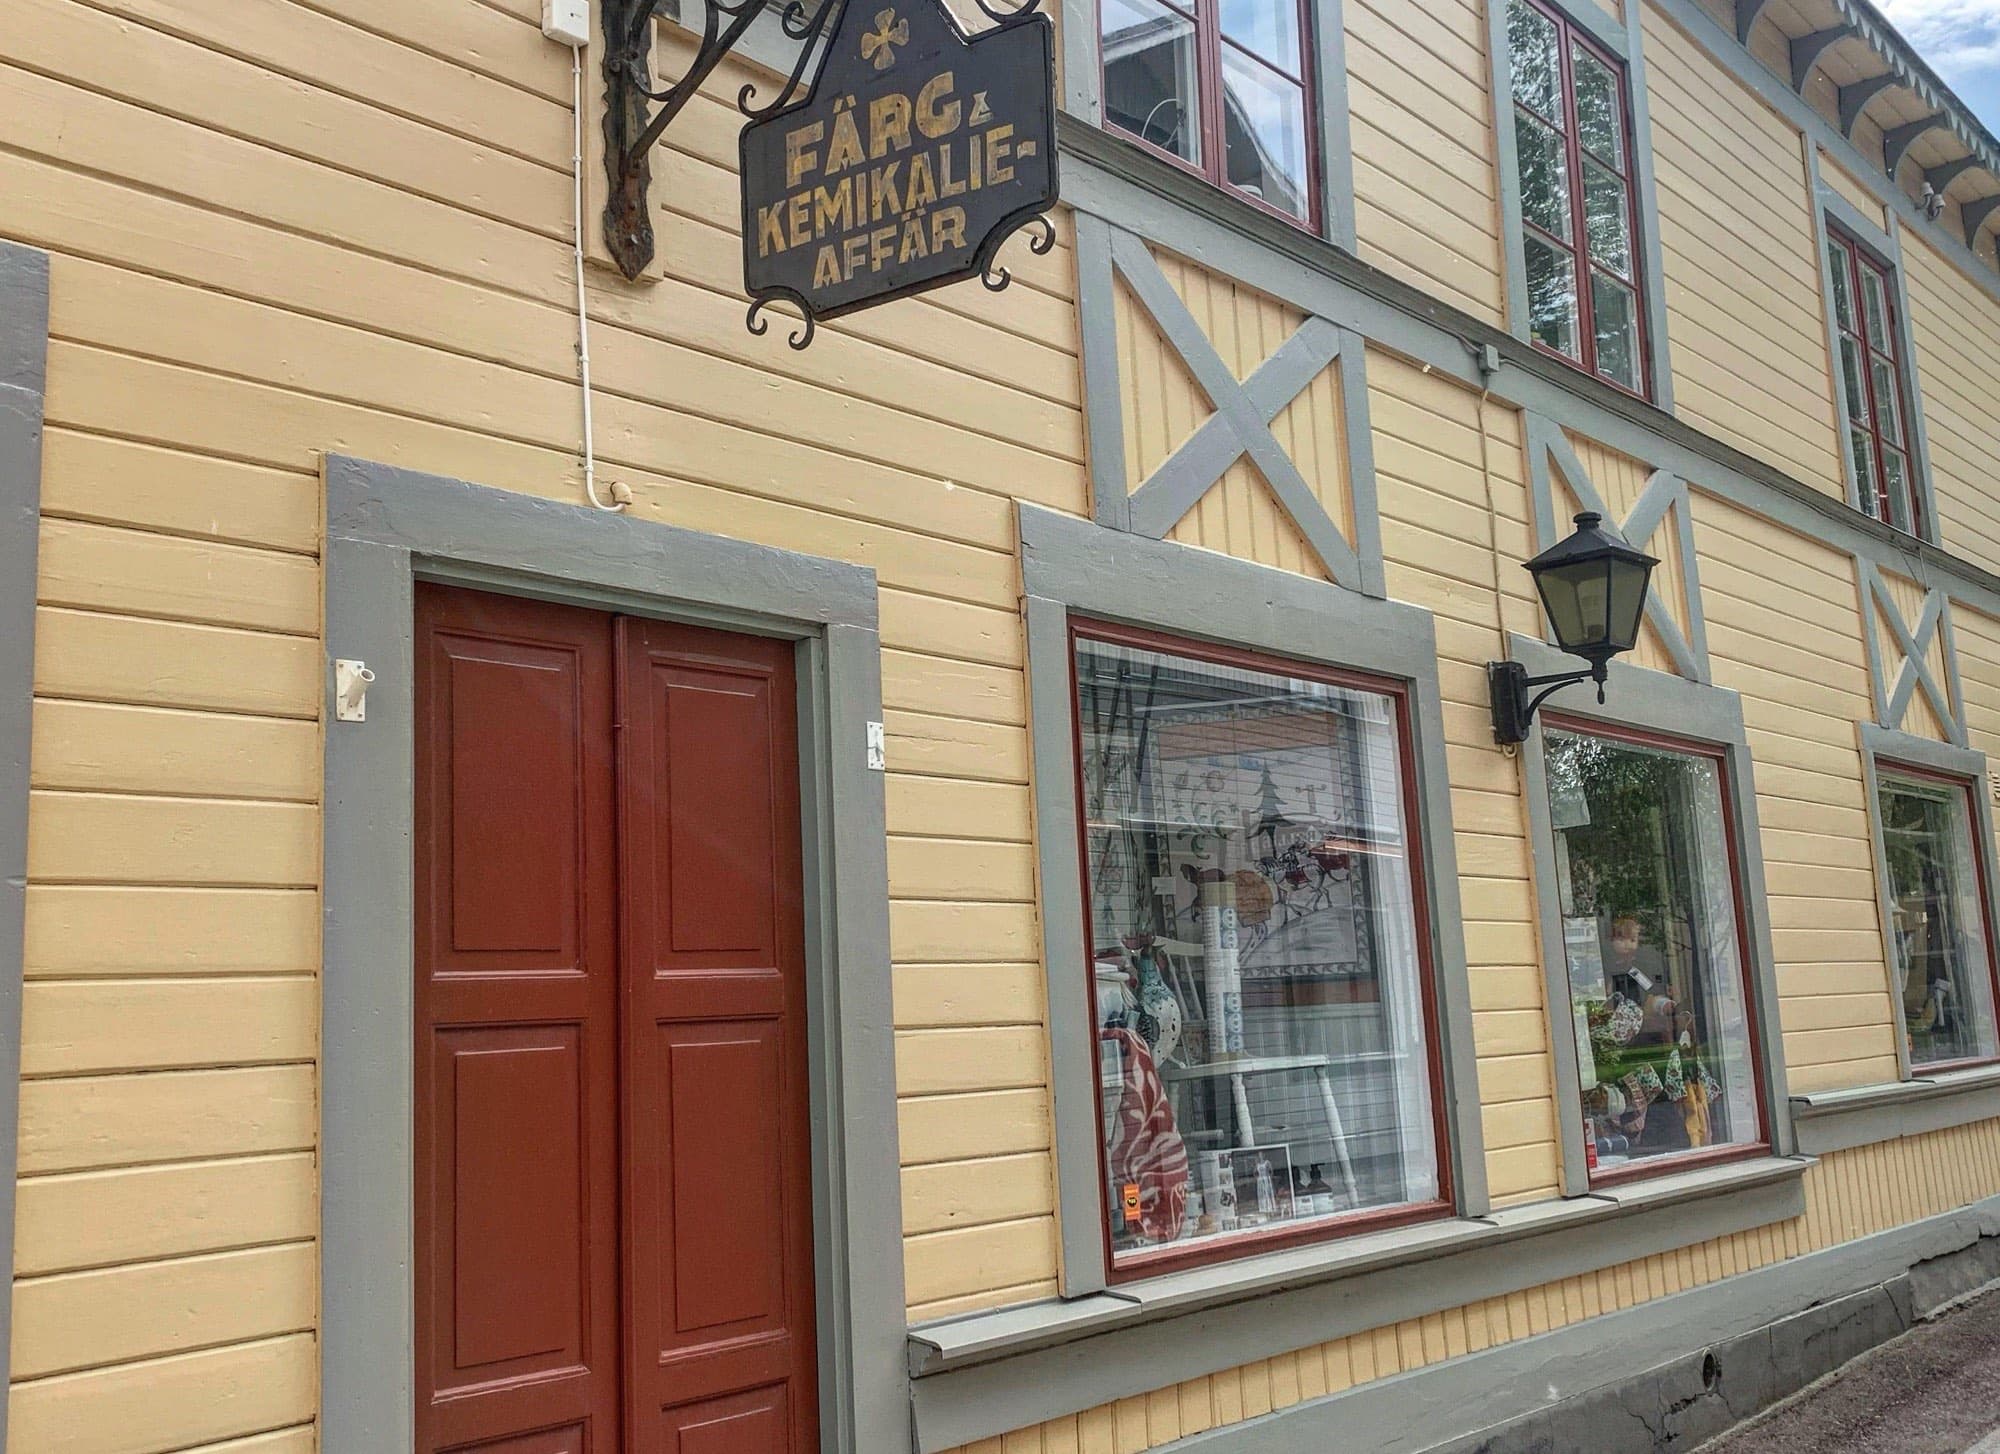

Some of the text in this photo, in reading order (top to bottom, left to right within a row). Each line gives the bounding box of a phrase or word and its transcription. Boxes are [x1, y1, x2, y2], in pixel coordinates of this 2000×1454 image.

[786, 71, 962, 189] FÄRG
[758, 124, 1036, 258] KEMIKALIE-
[812, 206, 967, 289] AFFÄR
